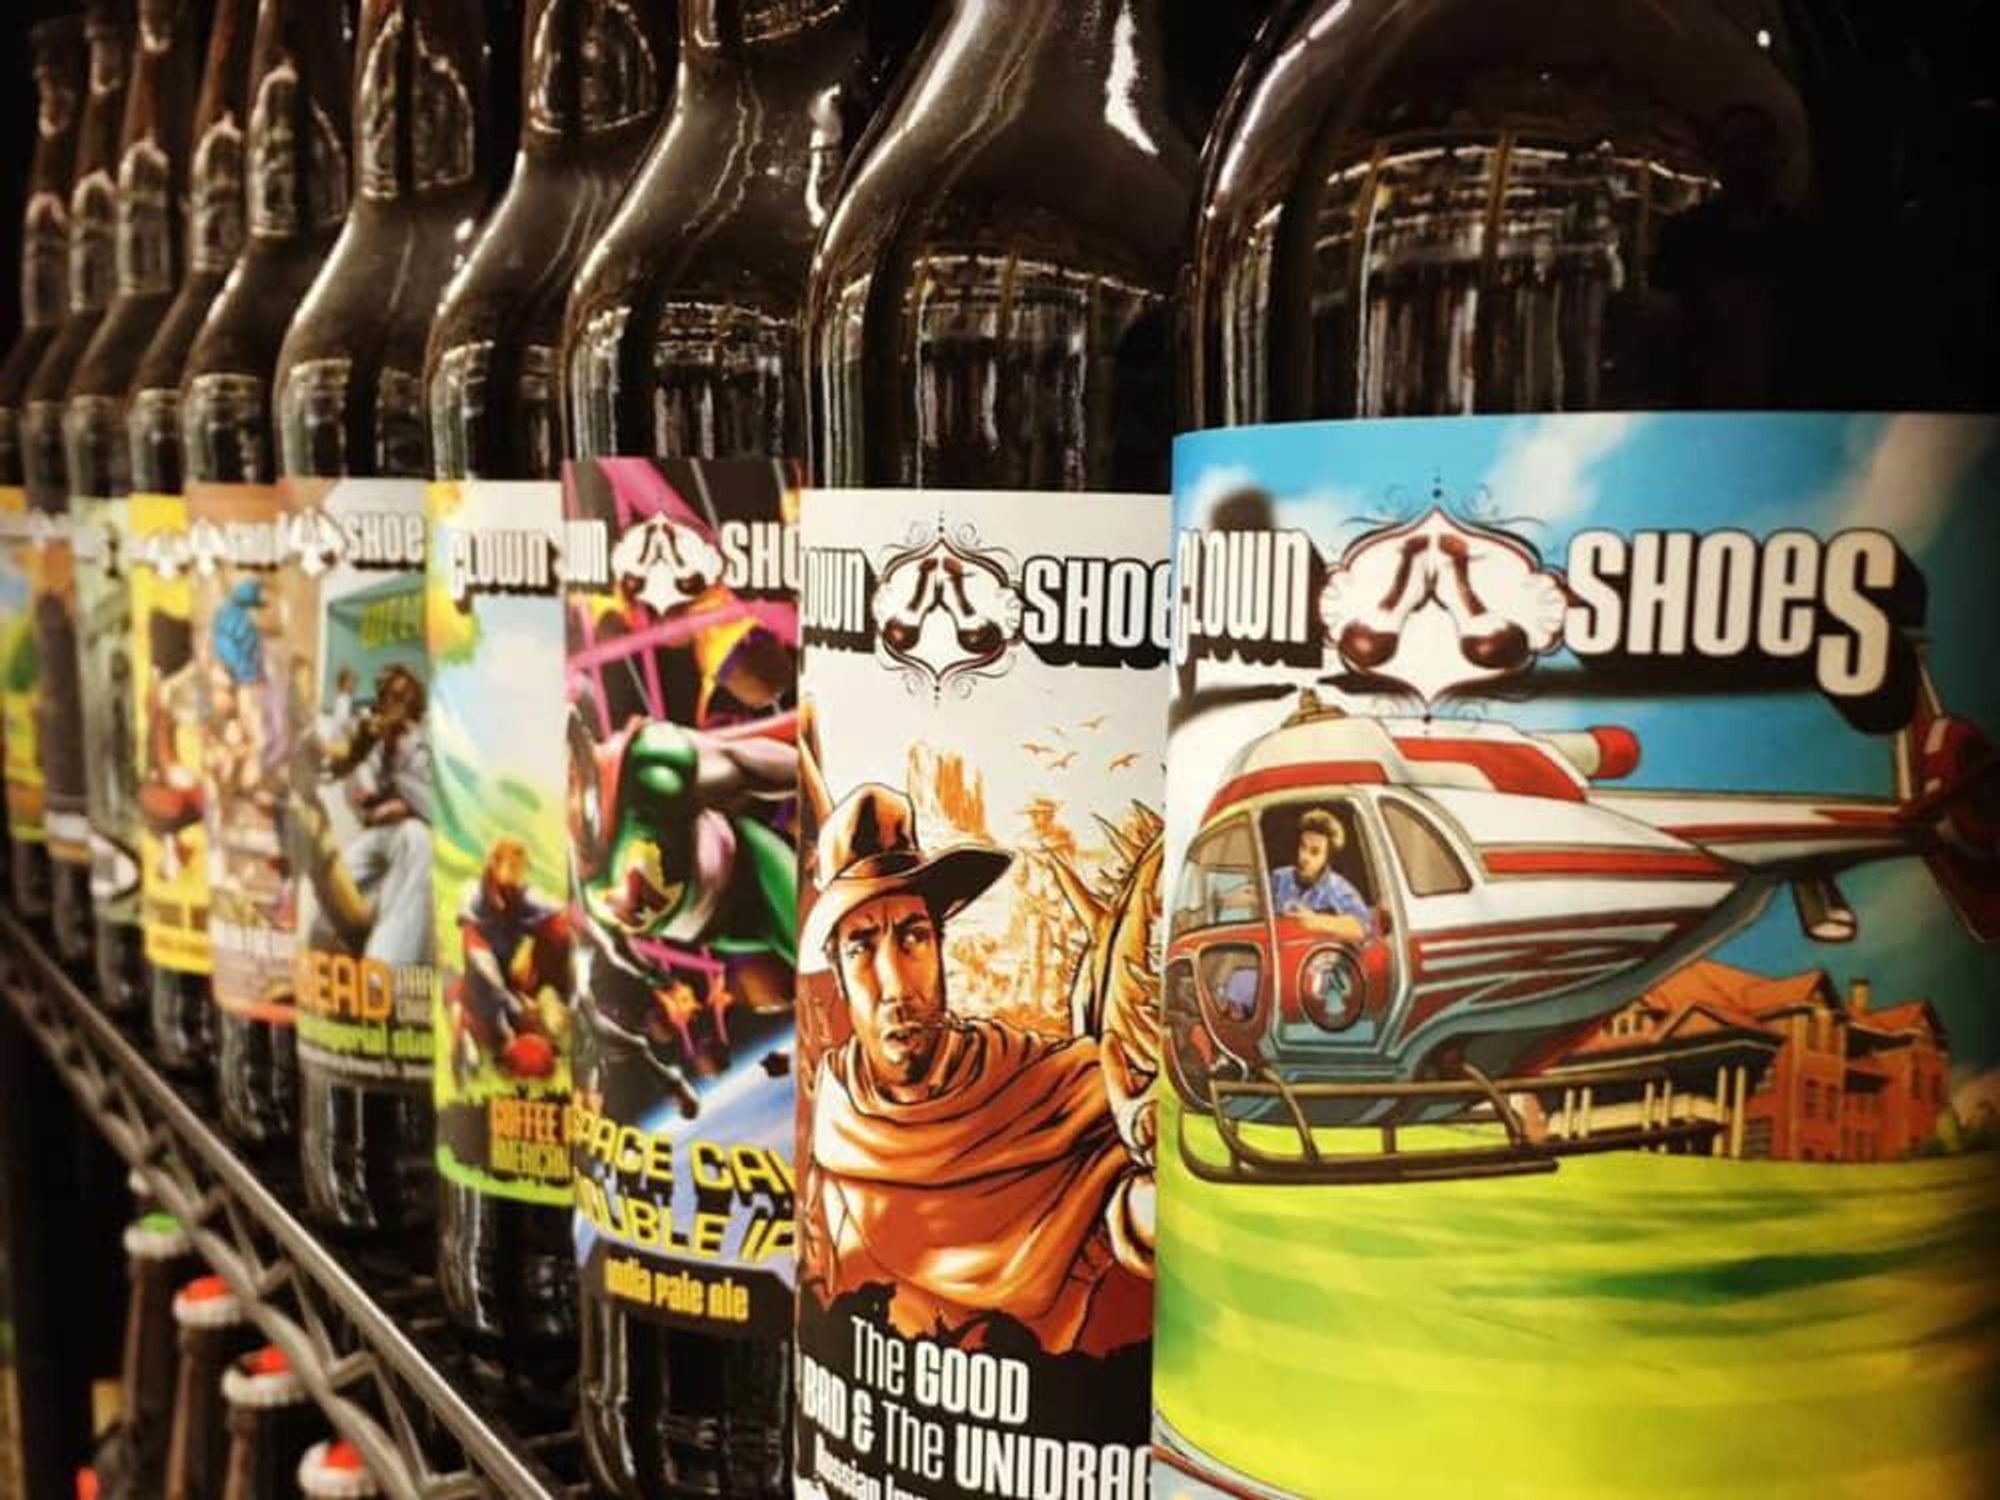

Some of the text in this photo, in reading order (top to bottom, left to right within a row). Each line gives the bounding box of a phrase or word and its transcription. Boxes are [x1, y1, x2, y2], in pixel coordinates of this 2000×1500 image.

[1177, 529, 1311, 666] CLOWN
[655, 1270, 704, 1316] pale
[708, 1277, 749, 1323] ale
[850, 1314, 1029, 1425] The GOOD
[852, 1389, 876, 1453] &
[881, 1400, 945, 1481] The
